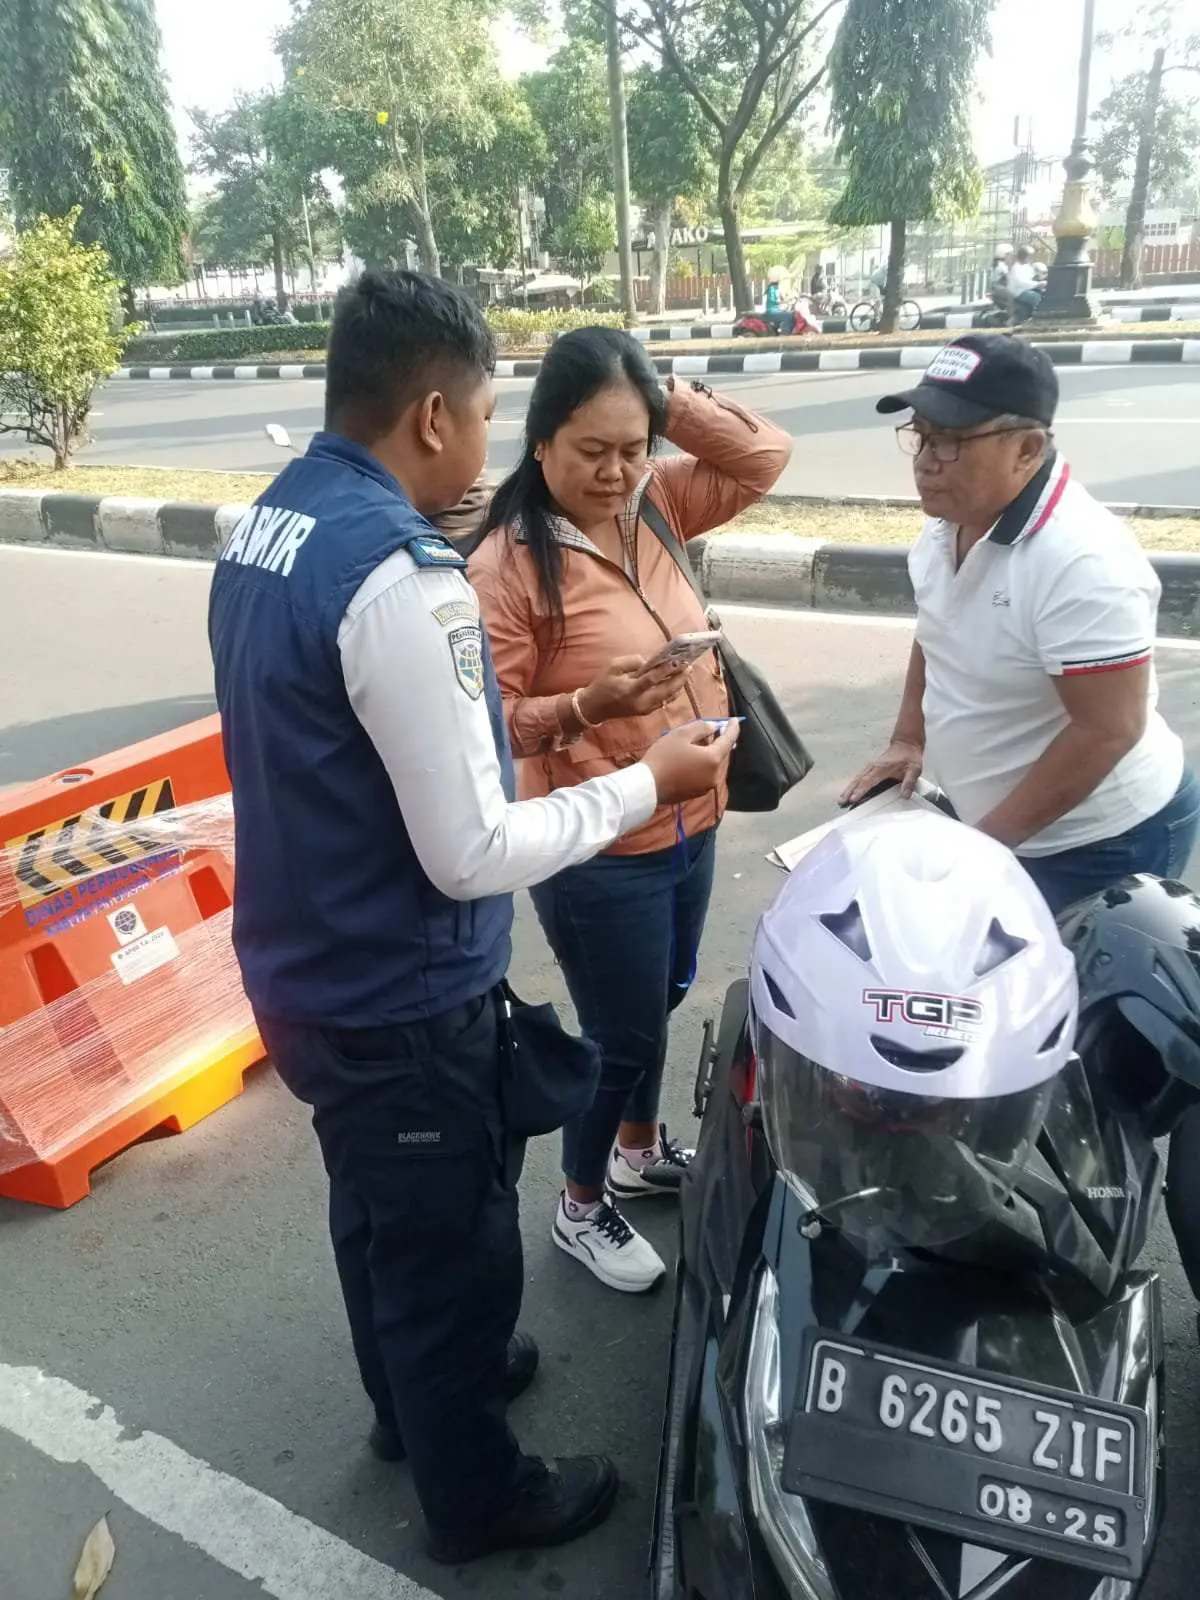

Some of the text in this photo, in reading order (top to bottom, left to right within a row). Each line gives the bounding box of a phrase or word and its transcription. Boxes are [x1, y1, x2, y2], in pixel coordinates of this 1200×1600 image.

[220, 505, 317, 577] ARKIR
[863, 988, 984, 1028] TGP
[1087, 1186, 1125, 1199] HONDA
[817, 1357, 1122, 1482] B 6265 ZIF
